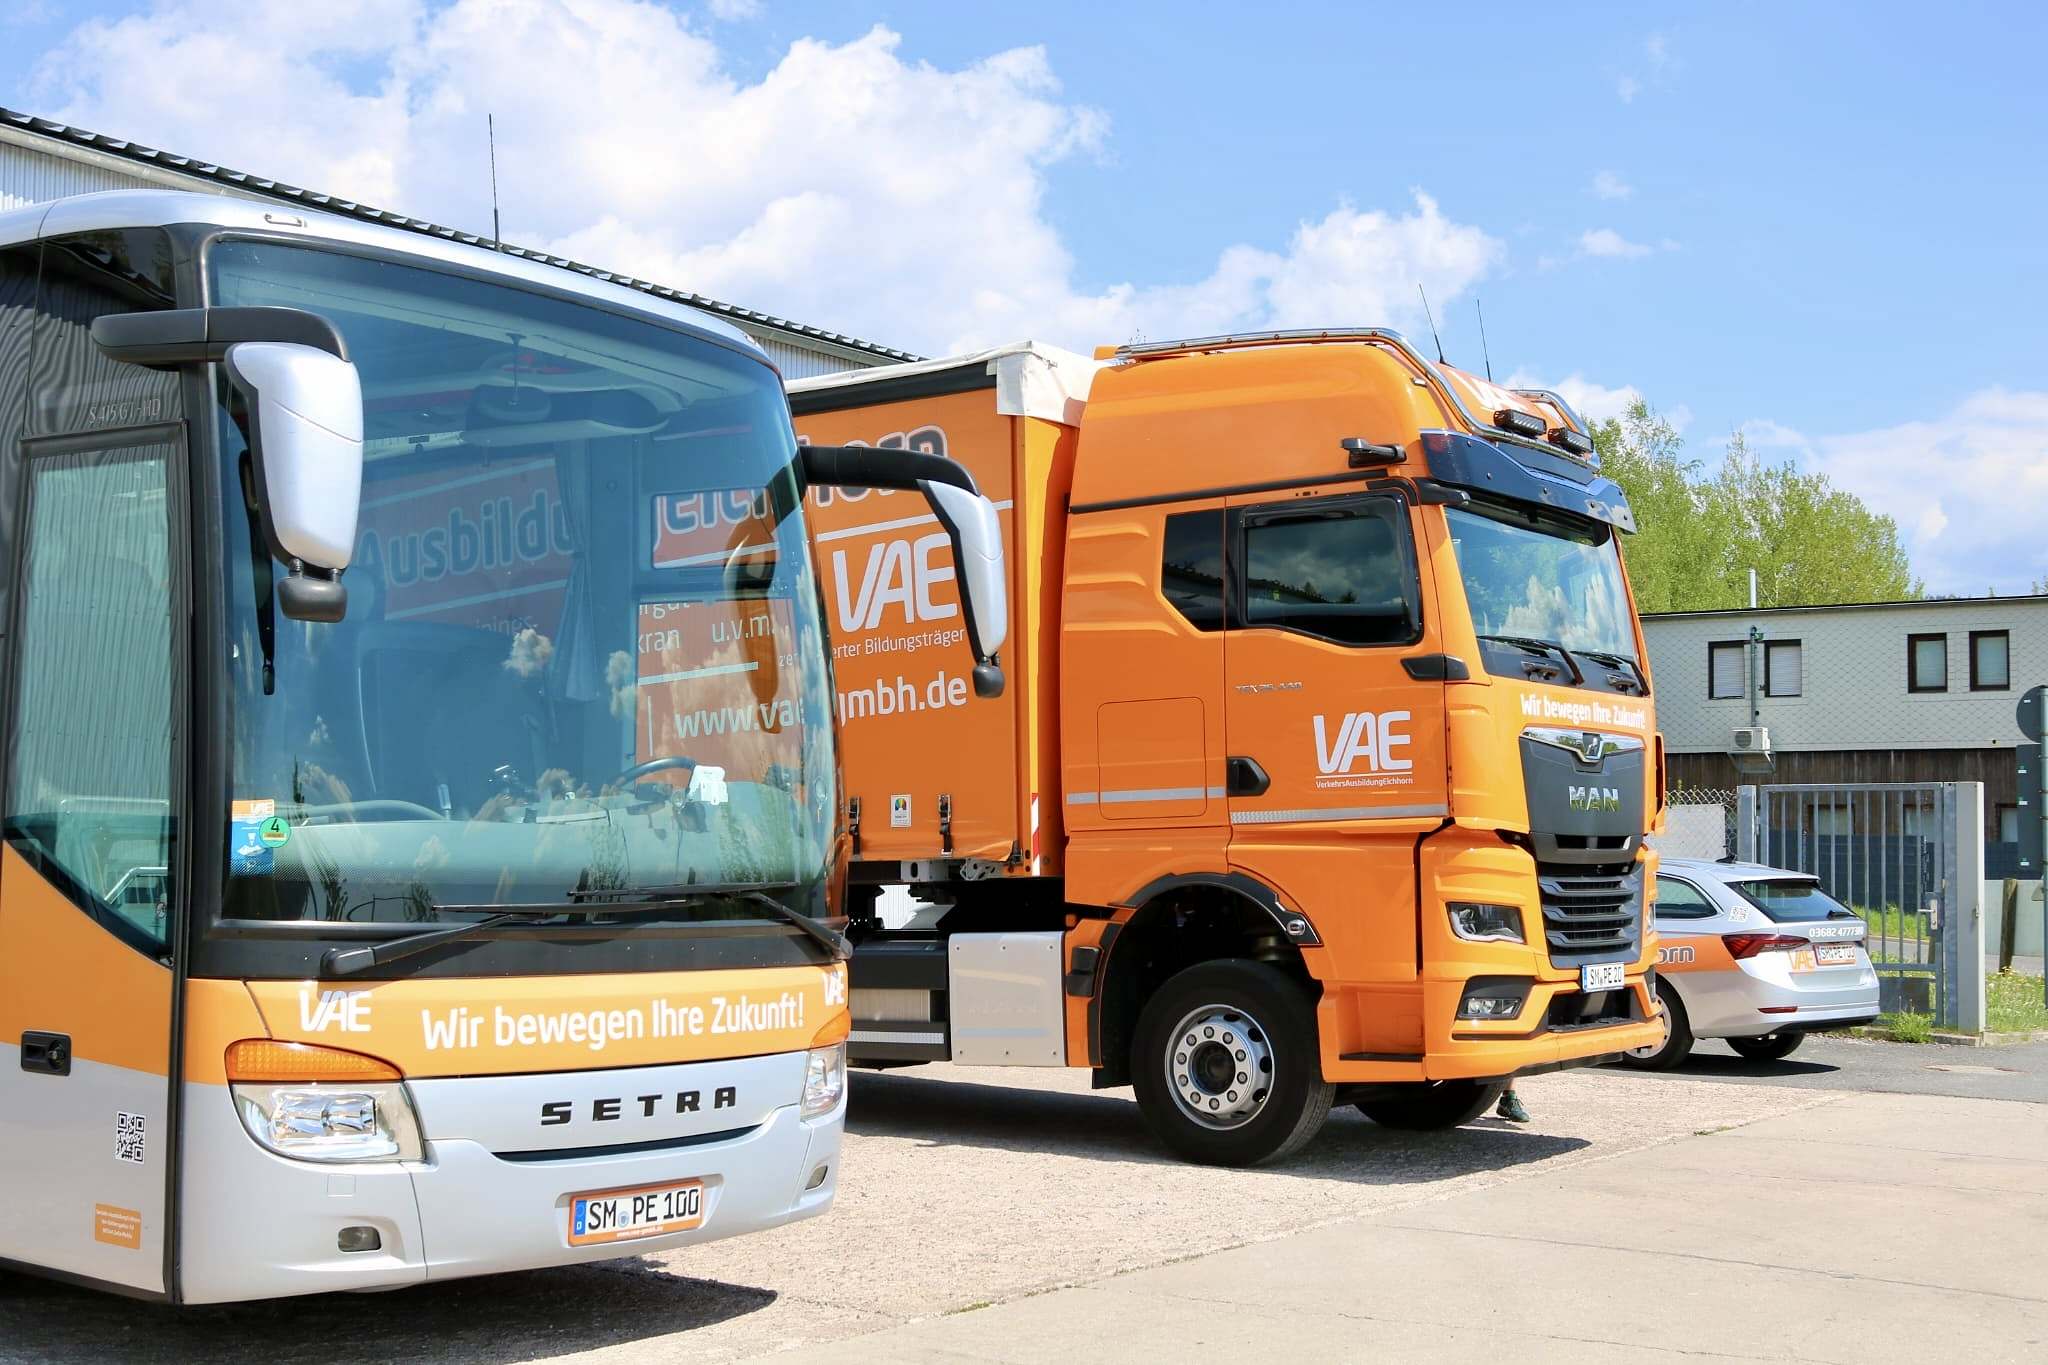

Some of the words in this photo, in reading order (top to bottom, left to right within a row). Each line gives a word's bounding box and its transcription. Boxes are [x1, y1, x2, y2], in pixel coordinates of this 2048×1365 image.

[832, 533, 958, 633] VAE
[865, 628, 965, 654] Bildungsträger
[1520, 693, 1541, 716] Wir
[1543, 696, 1591, 725] bewegen
[1313, 710, 1413, 773] VAE
[1315, 777, 1414, 788] VerkehrsAusbildungEichhorn
[1568, 785, 1619, 812] MAN
[270, 818, 280, 833] 4
[823, 971, 845, 1006] VAE
[299, 990, 373, 1032] VAE
[421, 1006, 485, 1050] Wir
[494, 1005, 644, 1051] bewegen
[652, 998, 705, 1038] Ihre
[710, 991, 804, 1034] Zukunft!
[541, 1086, 736, 1126] SETRA
[588, 1199, 617, 1230] SM
[632, 1194, 658, 1225] PE
[662, 1188, 700, 1220] 100
